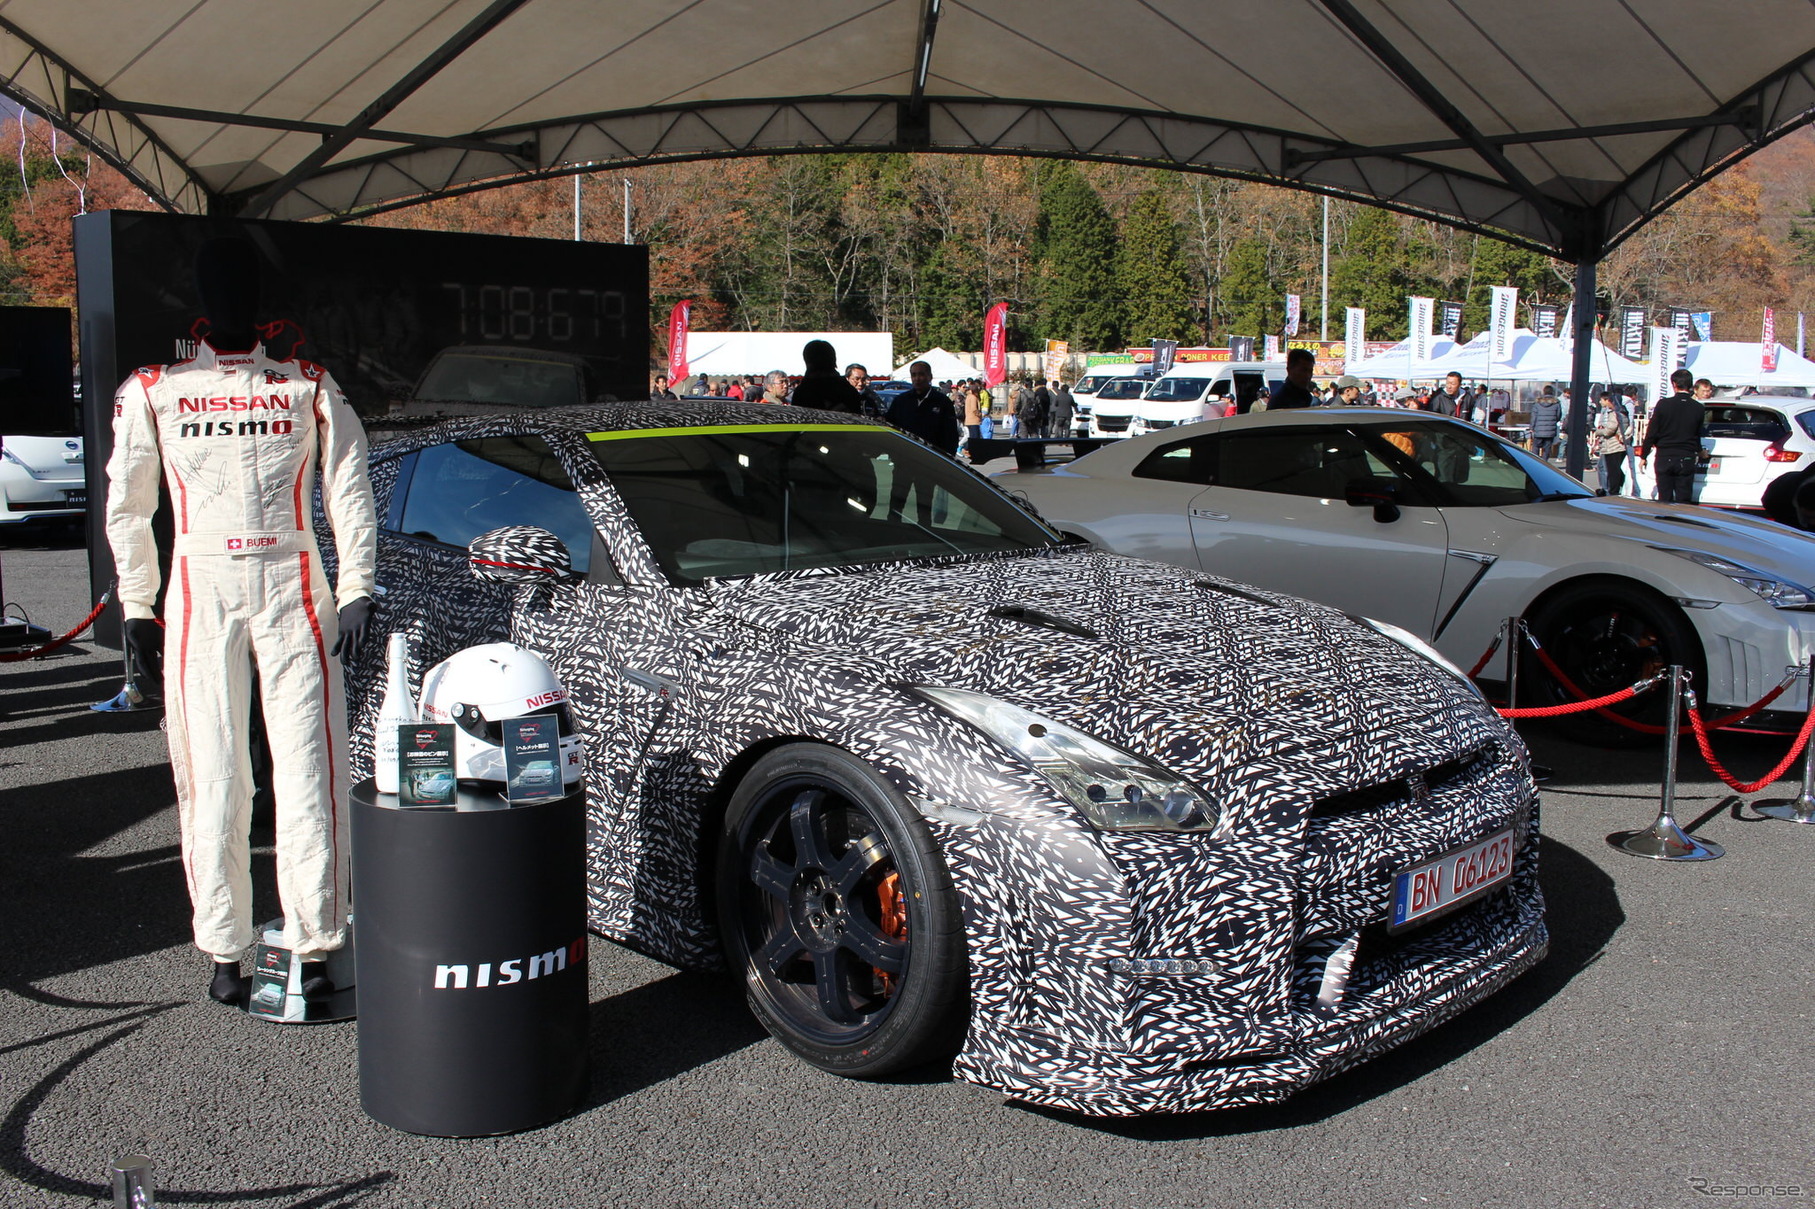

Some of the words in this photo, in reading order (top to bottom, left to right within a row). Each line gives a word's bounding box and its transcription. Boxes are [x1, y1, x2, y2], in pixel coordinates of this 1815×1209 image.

[990, 324, 999, 369] NISSAN
[1497, 293, 1510, 357] BRIDGESTONE
[179, 394, 290, 413] NISSAN
[181, 420, 293, 437] nismo
[246, 537, 277, 547] BUEMI
[1411, 865, 1442, 912] BN
[1452, 837, 1510, 894] 06123
[434, 936, 585, 989] nismo
